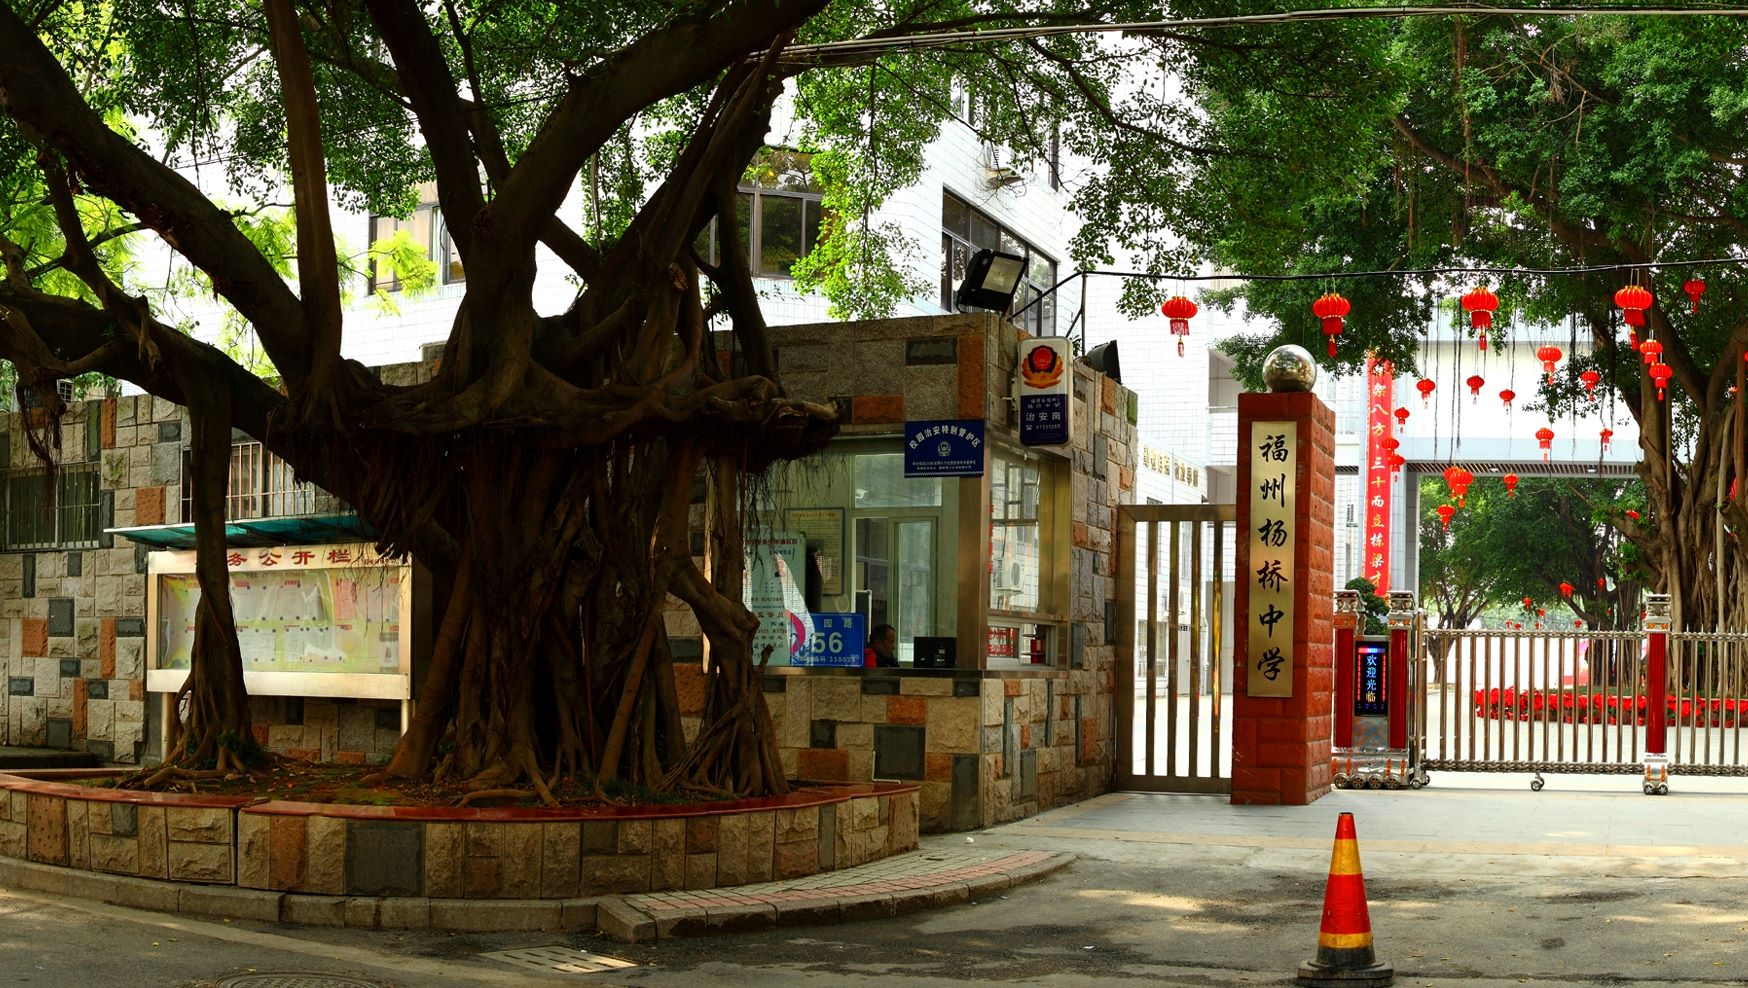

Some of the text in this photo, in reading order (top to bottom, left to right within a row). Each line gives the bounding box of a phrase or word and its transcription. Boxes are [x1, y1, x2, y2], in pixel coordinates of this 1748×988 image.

[1025, 410, 1061, 422] 治安岗
[909, 425, 981, 450] 校园治安特别管护区
[196, 549, 351, 567] 务公开栏
[1256, 434, 1289, 682] 福州杨桥中学
[813, 631, 843, 654] 56
[1365, 654, 1377, 703] 欢迎光临
